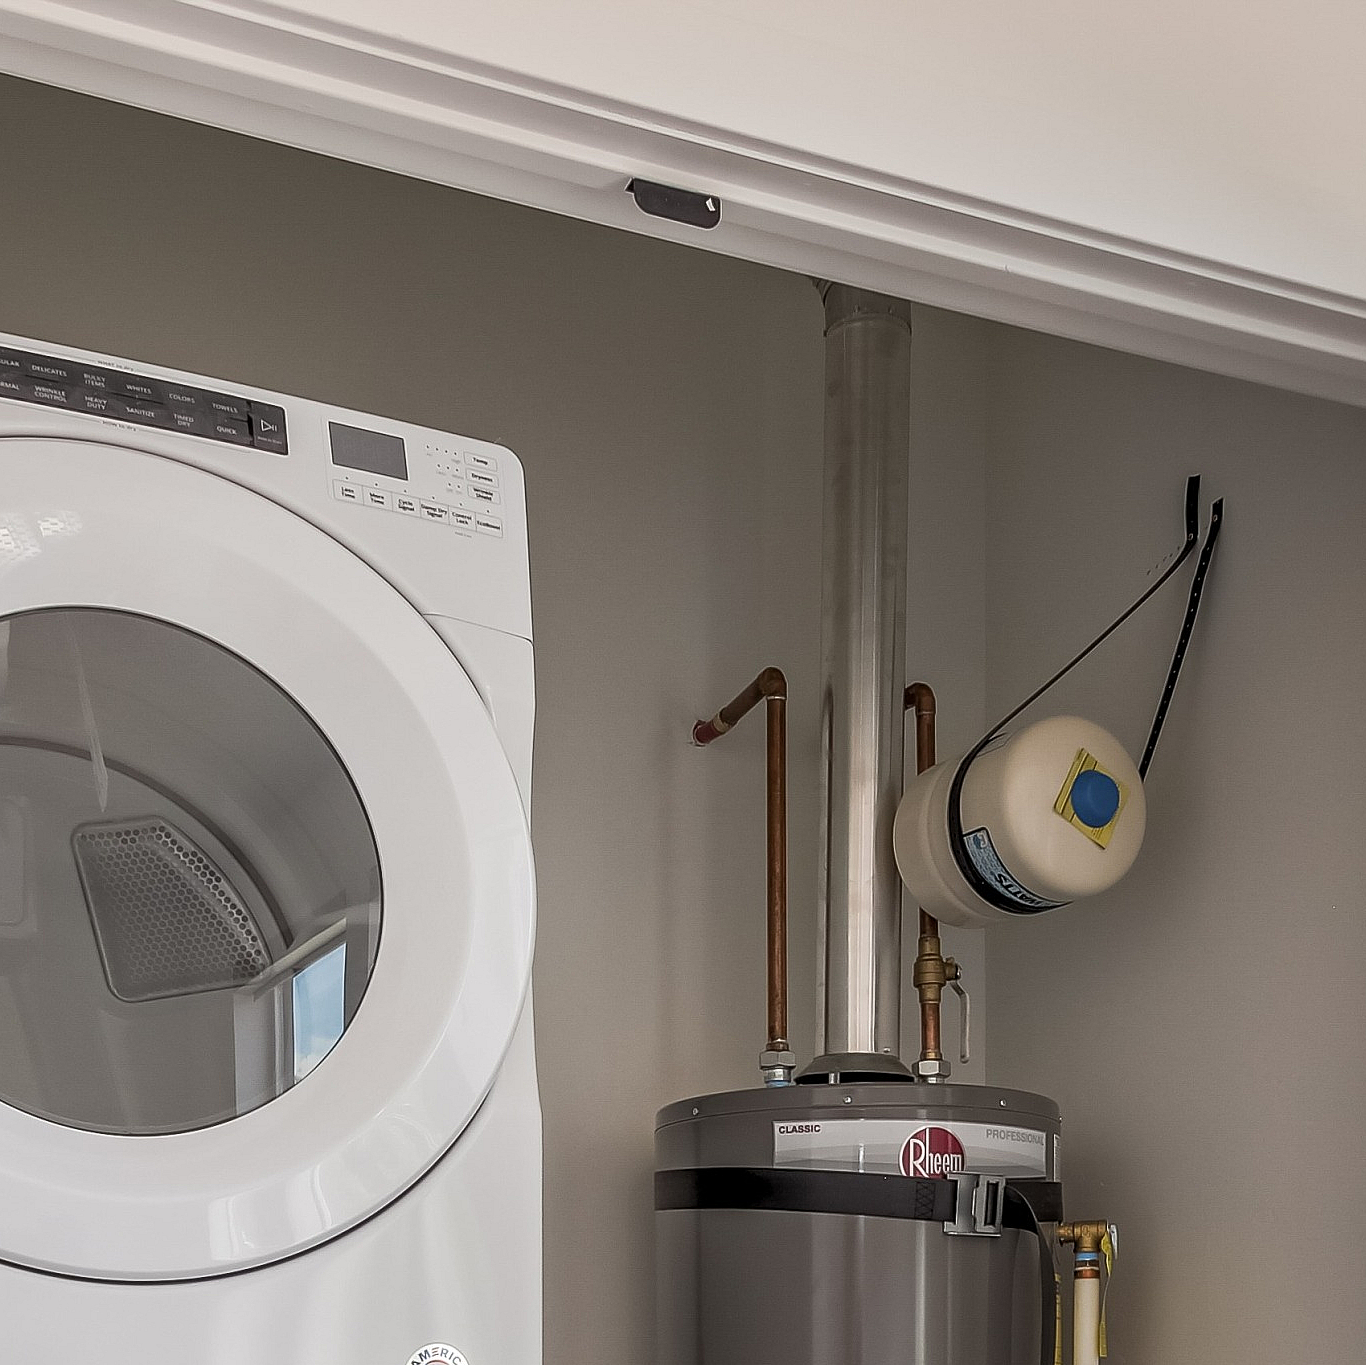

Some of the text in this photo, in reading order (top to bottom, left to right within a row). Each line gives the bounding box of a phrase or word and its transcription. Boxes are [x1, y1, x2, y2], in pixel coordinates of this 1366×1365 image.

[32, 365, 67, 377] DELICATES
[35, 385, 66, 396] WRINKLE
[126, 384, 152, 394] WHITES
[35, 391, 67, 403] CONTROL
[169, 393, 195, 404] COLORS
[87, 401, 106, 410] DUTY
[212, 403, 238, 414] TOWELS
[126, 407, 155, 418] SANITIZE
[217, 425, 237, 435] QUICK
[995, 873, 1043, 906] WATTS
[778, 1125, 821, 1134] CLASSIC
[986, 1129, 1044, 1146] PROFESSIONAL
[909, 1127, 962, 1178] Rheem
